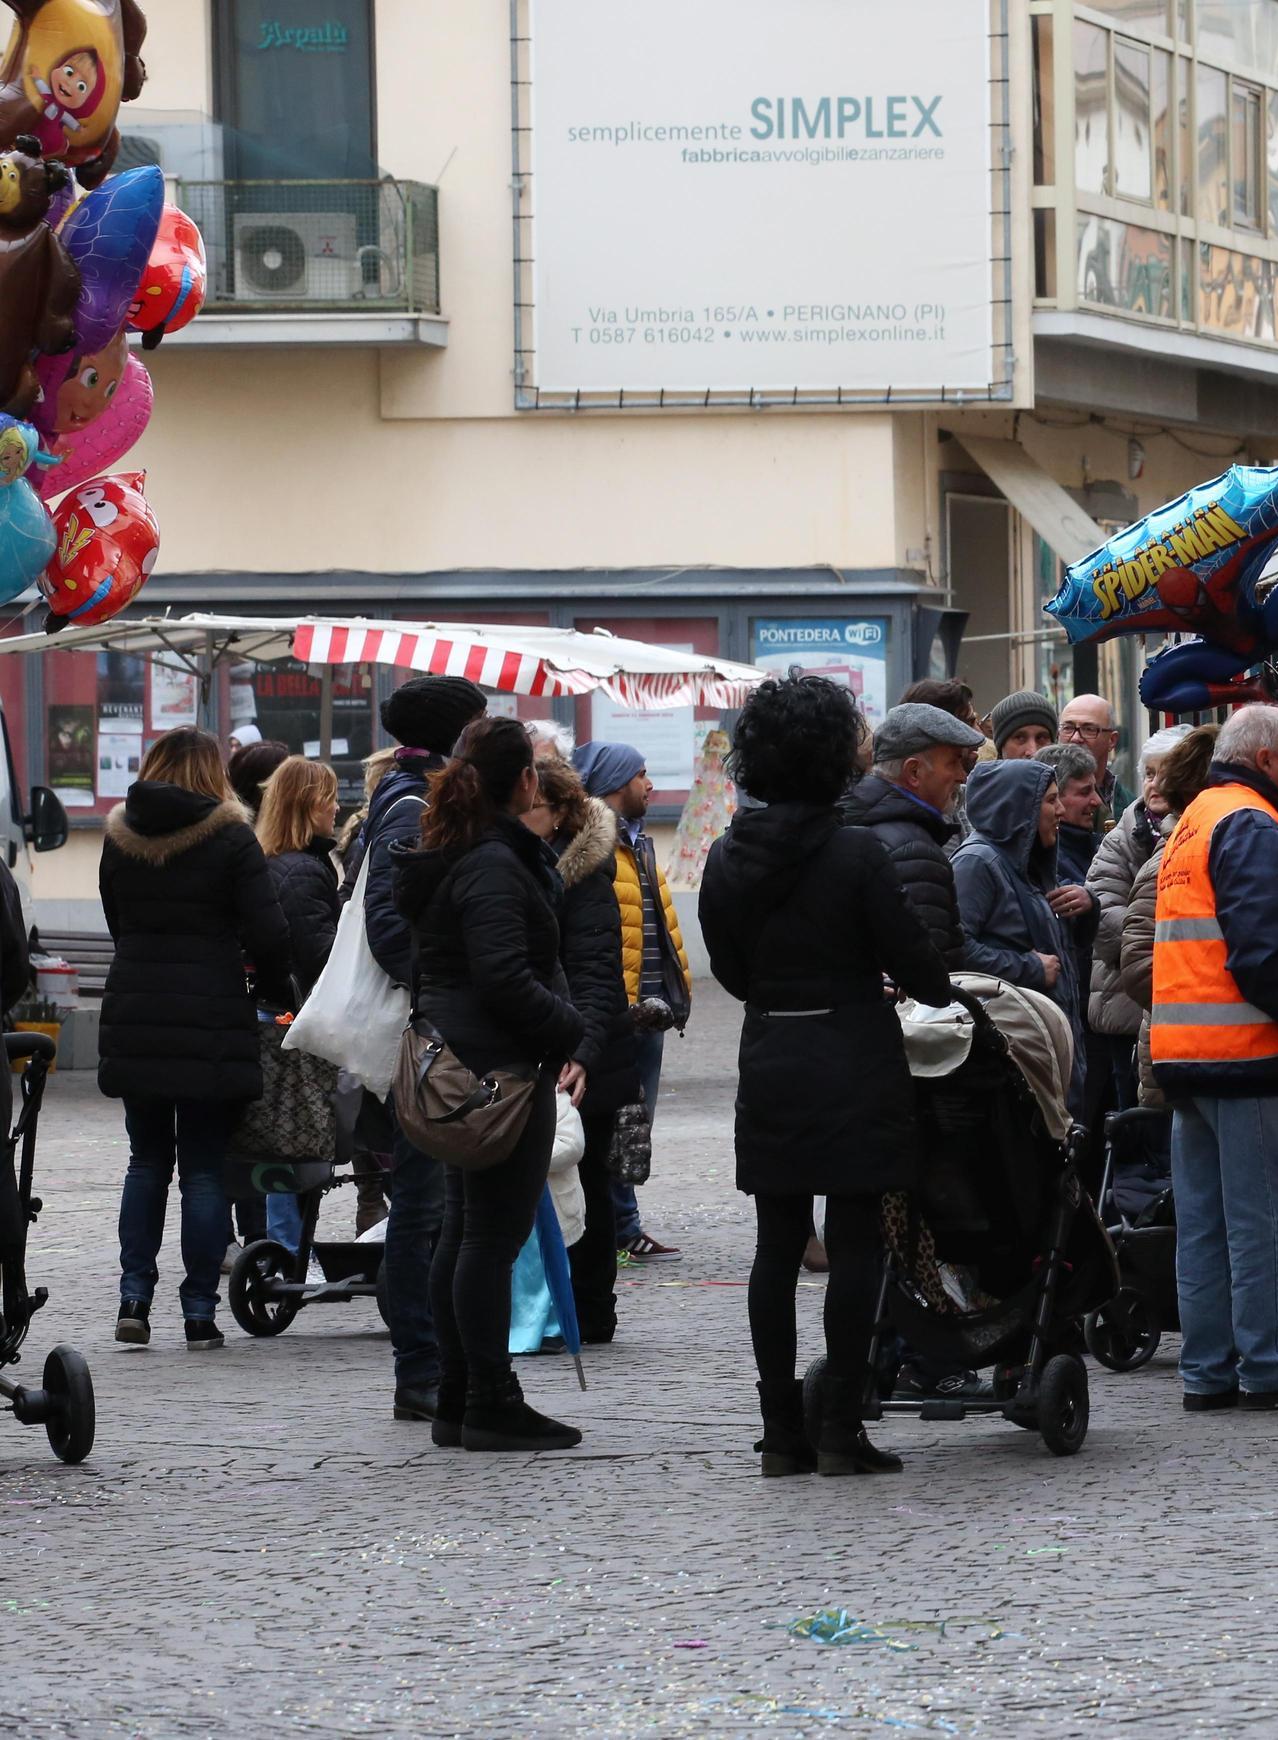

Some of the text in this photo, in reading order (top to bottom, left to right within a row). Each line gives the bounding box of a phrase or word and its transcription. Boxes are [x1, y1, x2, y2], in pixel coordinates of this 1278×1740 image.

[568, 95, 944, 147] semplicemente SIMPLEX
[682, 146, 944, 165] fabbricaavvolgibiliezanzariere
[588, 303, 946, 323] Via Umbria 165/A PERIGNANO (PI)
[571, 325, 945, 345] T 0587 616042 www.simplexonline.it
[1133, 500, 1219, 557] AMAZING
[1091, 504, 1249, 621] SPIDER-MAN
[759, 628, 841, 642] PONTEDERA
